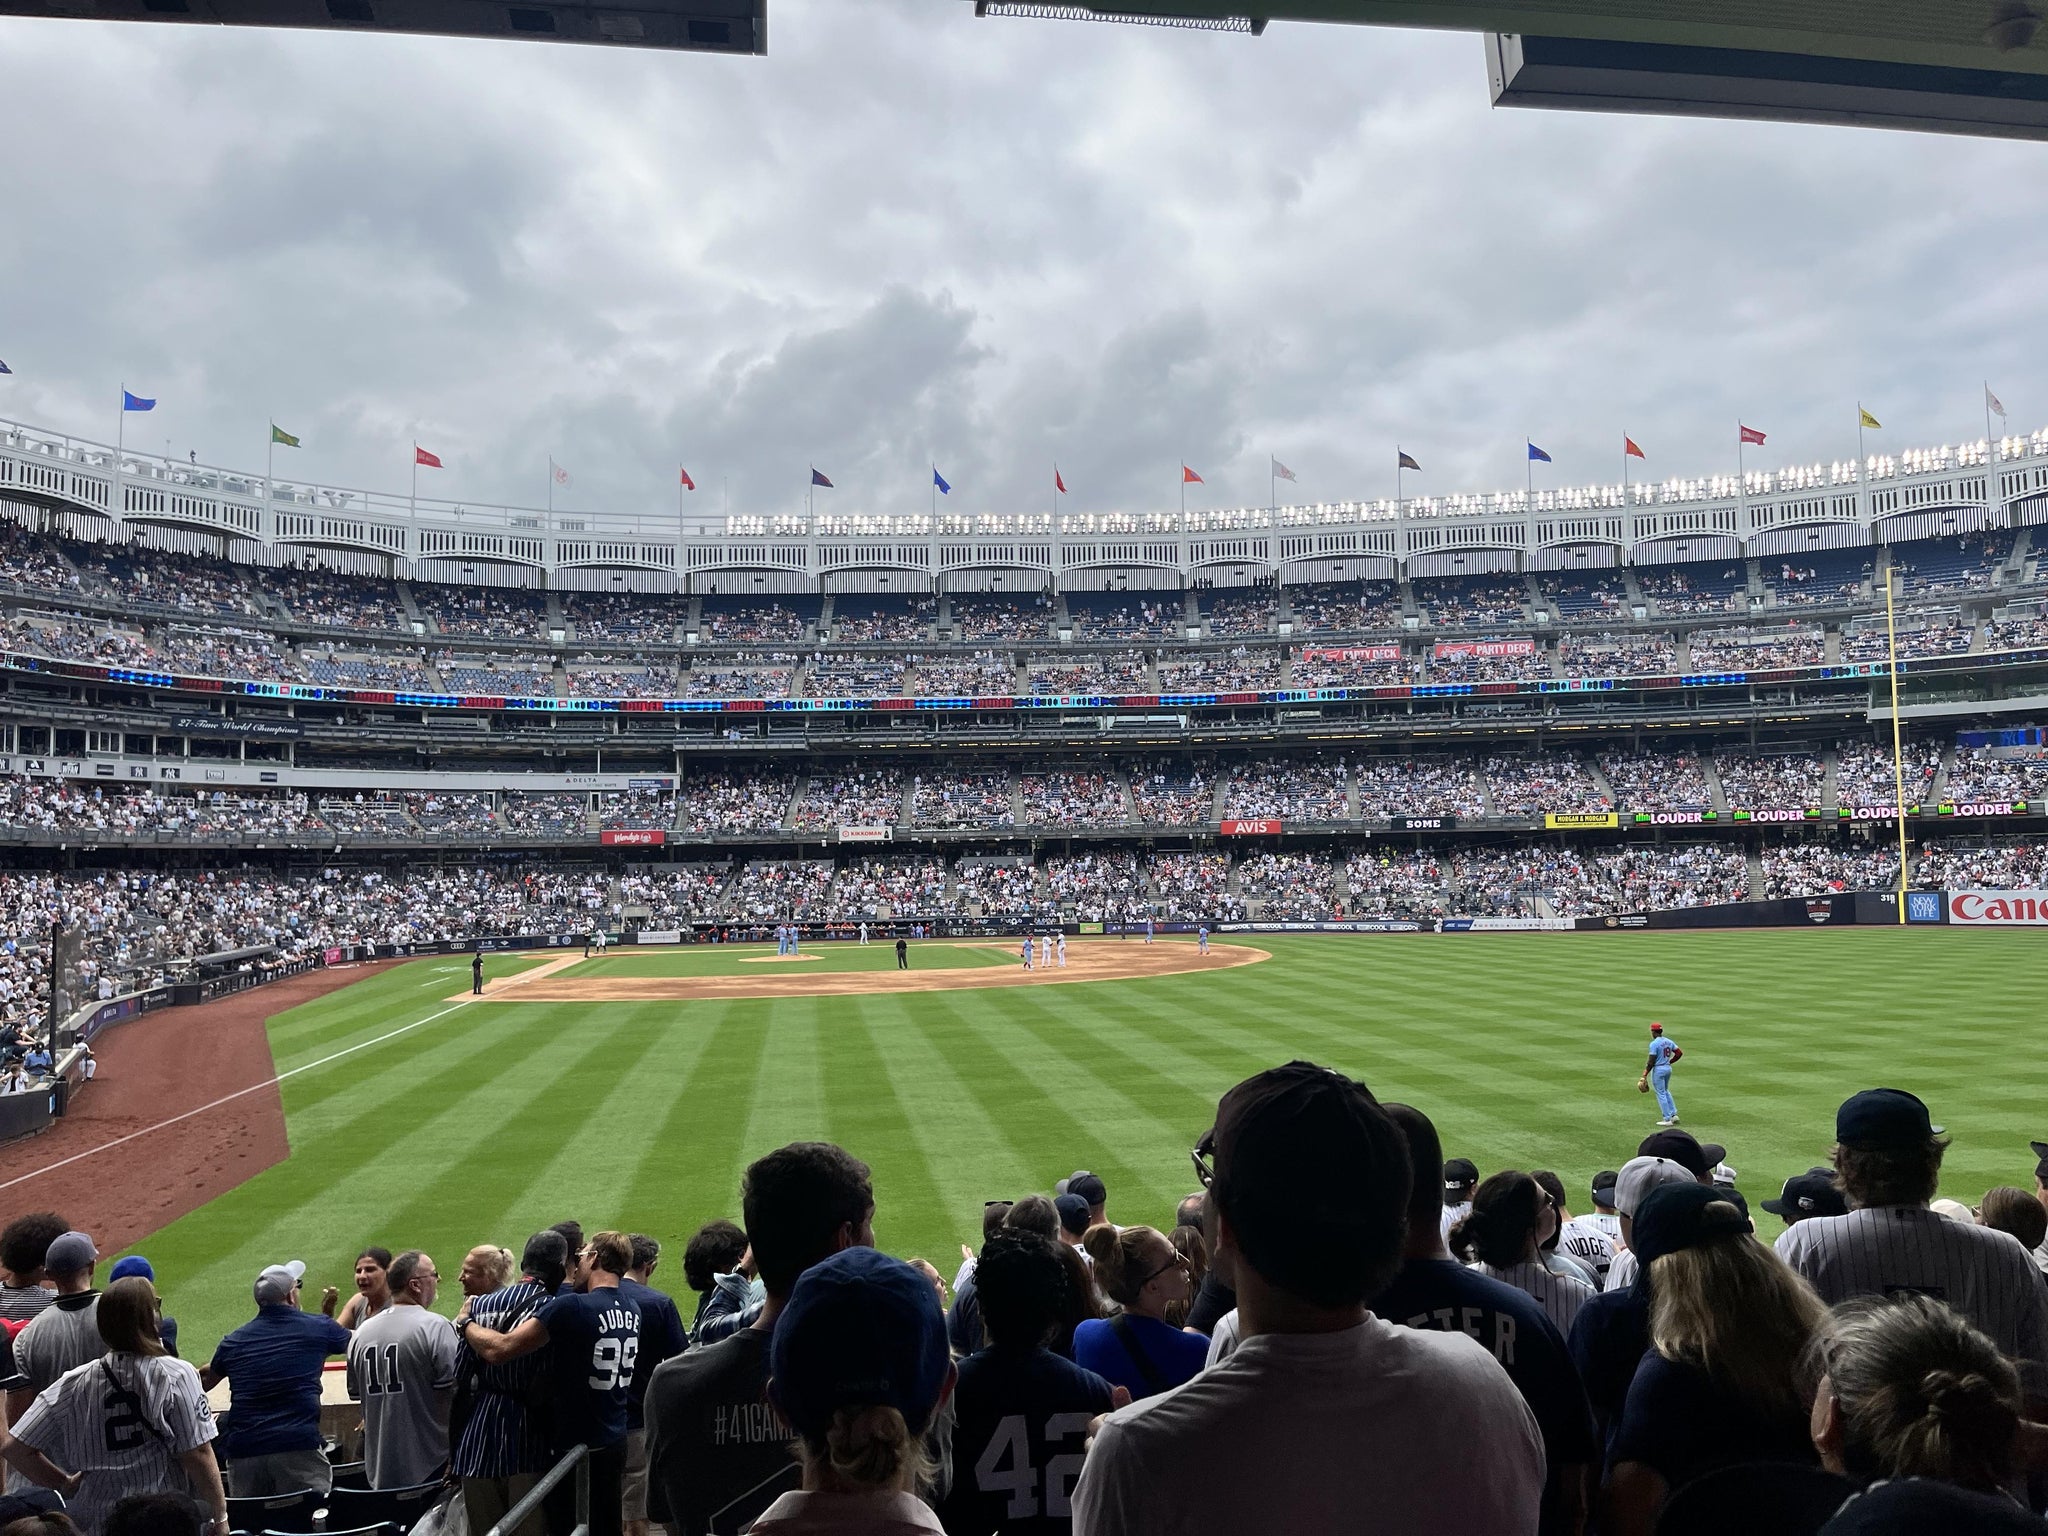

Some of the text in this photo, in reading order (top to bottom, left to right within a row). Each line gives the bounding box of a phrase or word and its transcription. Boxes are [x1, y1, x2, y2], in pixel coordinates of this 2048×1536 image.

[1373, 649, 1396, 659] DECK
[1477, 643, 1532, 655] PARTY DECK
[178, 719, 299, 736] 27-Time World Champions
[1750, 809, 1805, 823] LOUDER
[1953, 803, 2013, 817] LOUDER
[1406, 819, 1441, 829] SOME
[1557, 815, 1579, 823] MORGAN
[1585, 814, 1606, 822] MORGAN
[1650, 812, 1702, 824] LOUDER
[1235, 821, 1267, 833] AVIS
[614, 832, 640, 843] Wendy's
[1911, 902, 1937, 911] YORK
[1913, 897, 1934, 905] NEW
[1914, 909, 1935, 918] LIFE
[1663, 1046, 1671, 1058] 18
[598, 1309, 640, 1334] JUDGE
[363, 1343, 404, 1395] 11
[588, 1336, 639, 1391] 99
[103, 1390, 146, 1452] 2
[973, 1412, 1095, 1519] 42
